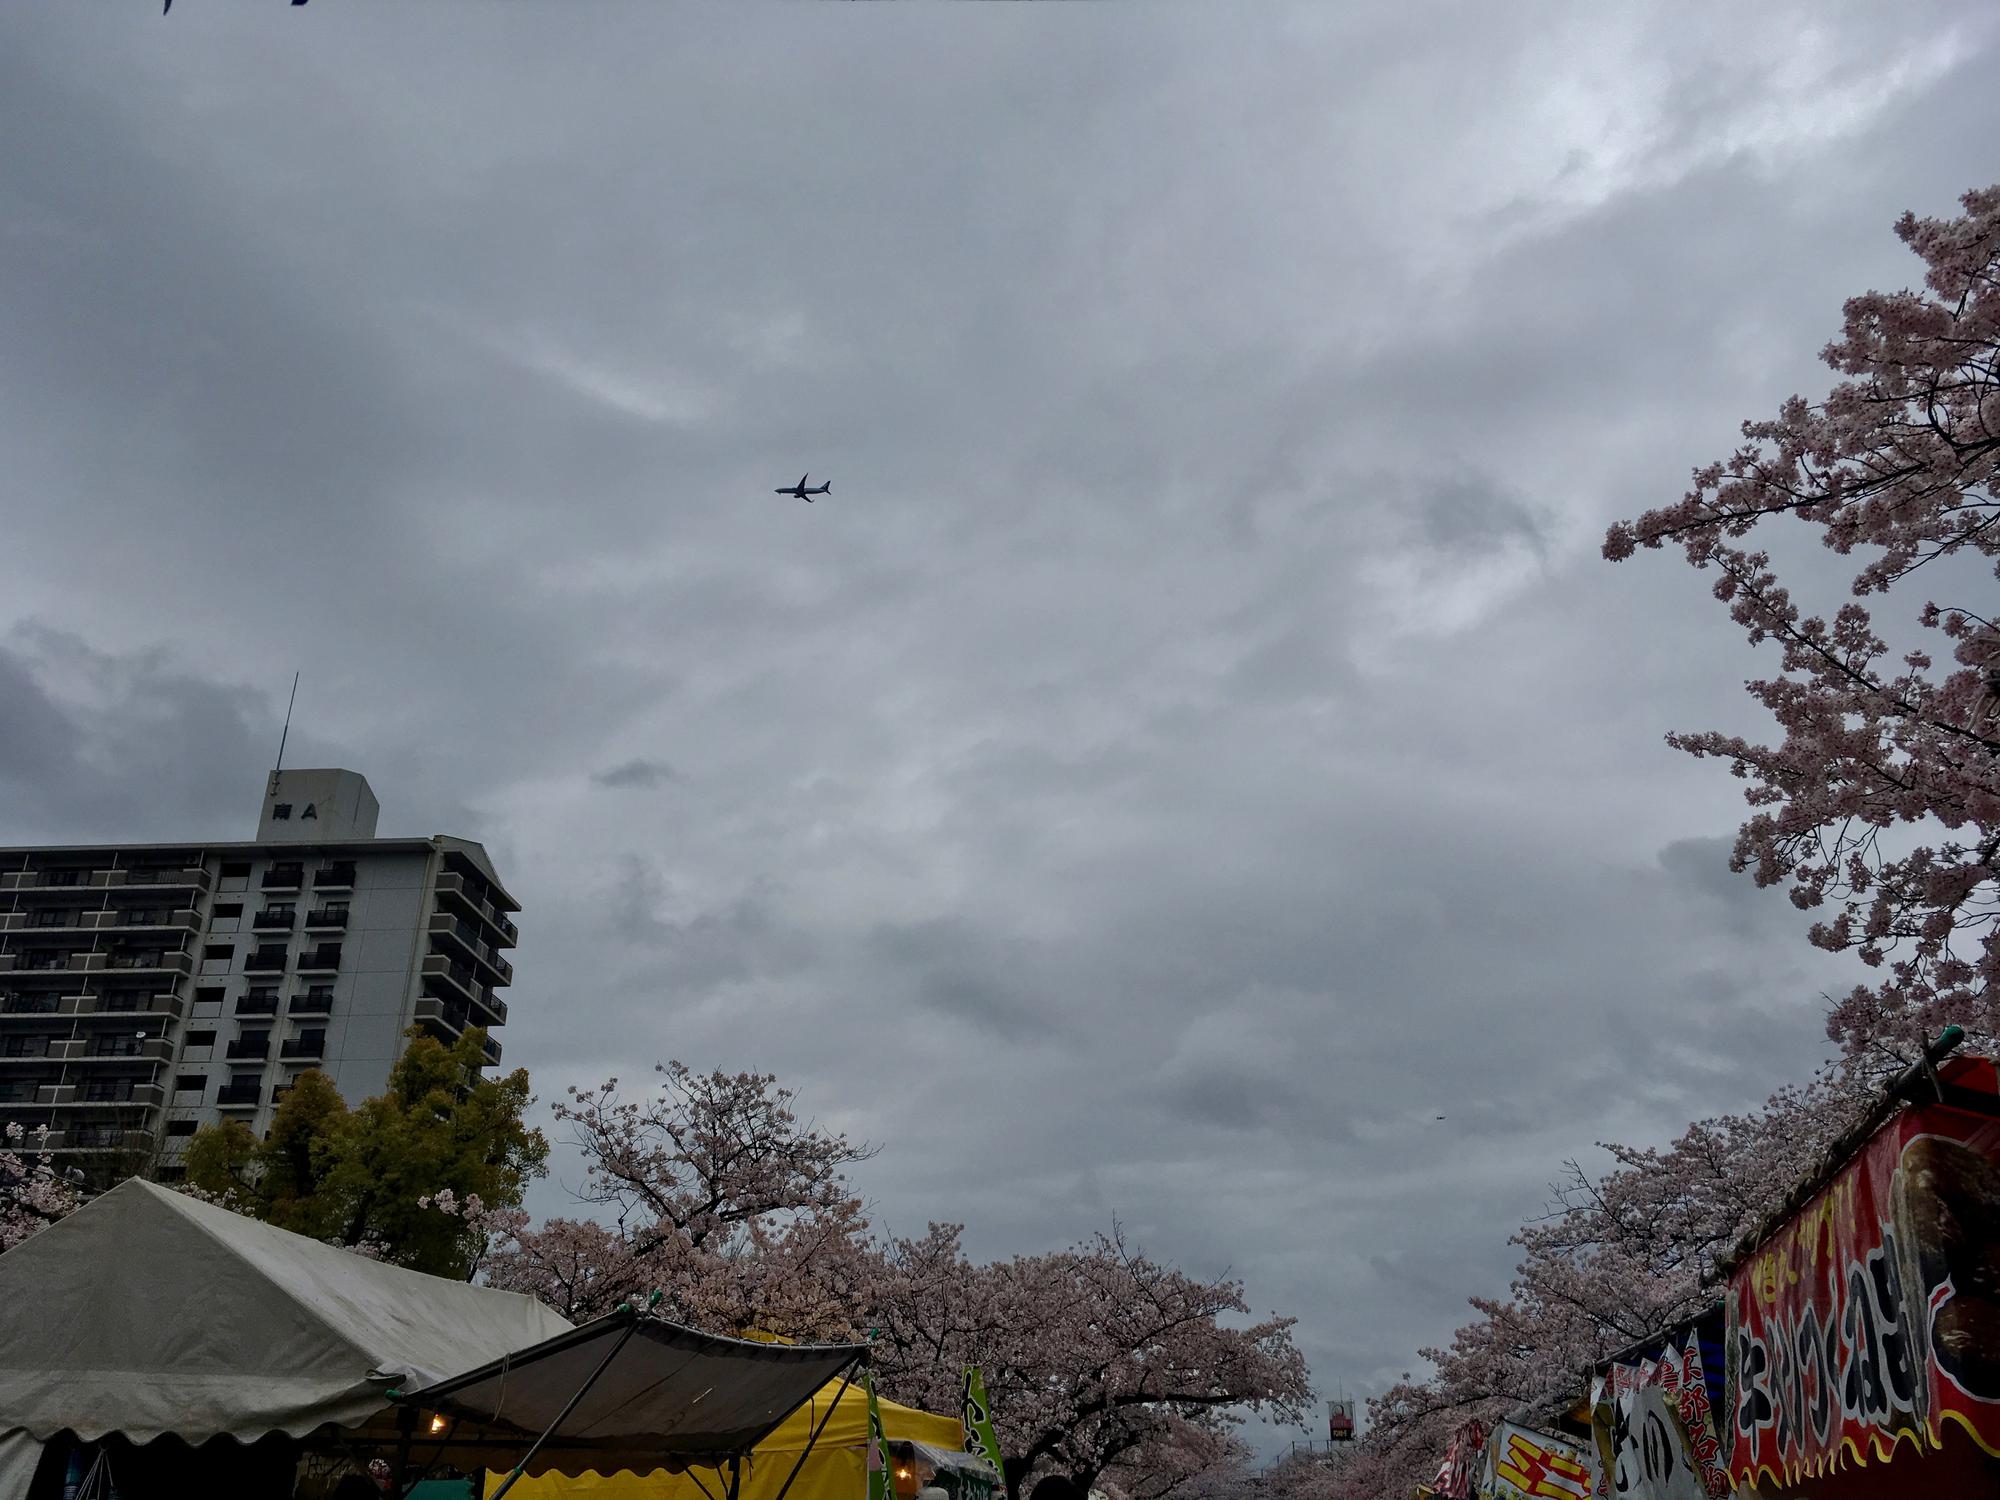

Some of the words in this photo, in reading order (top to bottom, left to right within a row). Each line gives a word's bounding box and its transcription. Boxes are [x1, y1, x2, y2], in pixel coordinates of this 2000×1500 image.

[273, 804, 292, 820] 南
[301, 804, 317, 820] A
[1497, 1433, 1592, 1500] ミニ
